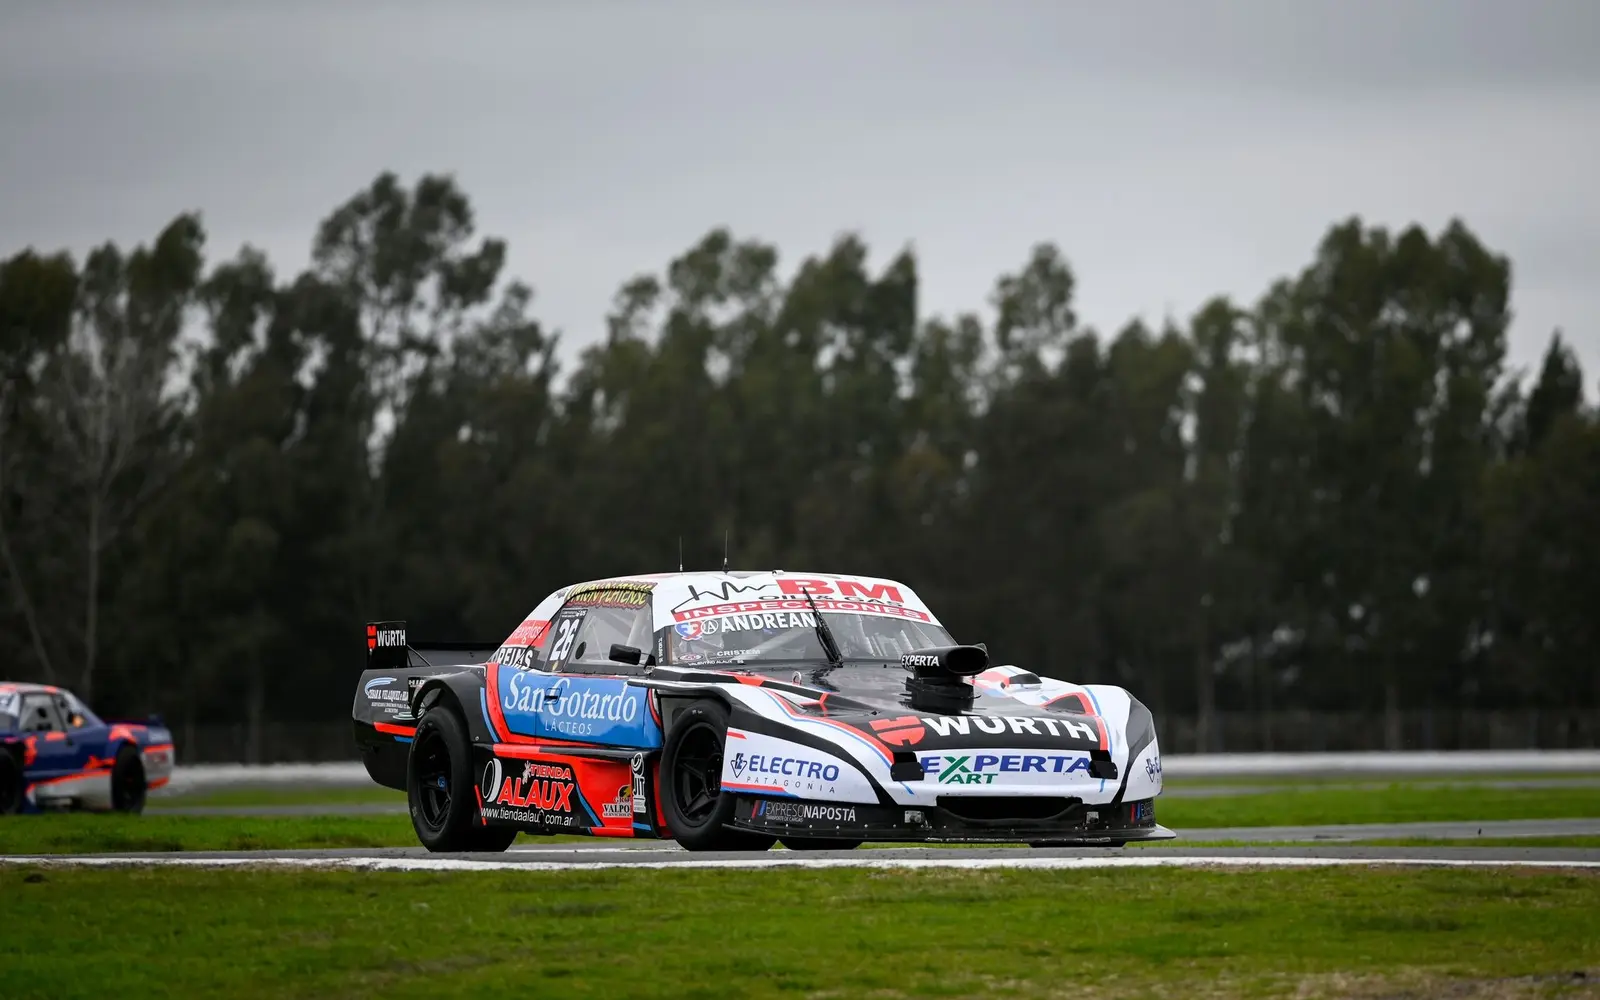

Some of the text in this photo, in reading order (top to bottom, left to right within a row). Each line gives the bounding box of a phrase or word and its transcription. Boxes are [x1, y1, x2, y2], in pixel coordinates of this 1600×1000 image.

[775, 579, 905, 603] BM
[683, 600, 921, 620] INSPECCIONES
[844, 596, 905, 608] GAS
[376, 629, 406, 647] WÜRTH
[549, 618, 580, 661] 26
[901, 654, 940, 668] EXPERTA
[504, 672, 637, 722] San Gotardo
[545, 718, 592, 735] LÁCTEOS
[921, 715, 1099, 742] WÜRTH
[530, 763, 572, 781] TIENDA
[748, 754, 840, 782] ELECTRO
[920, 755, 1091, 780] EXPERTA
[746, 776, 836, 793] PATAGONIA
[945, 773, 999, 785] ART
[497, 776, 575, 813] ALAUX
